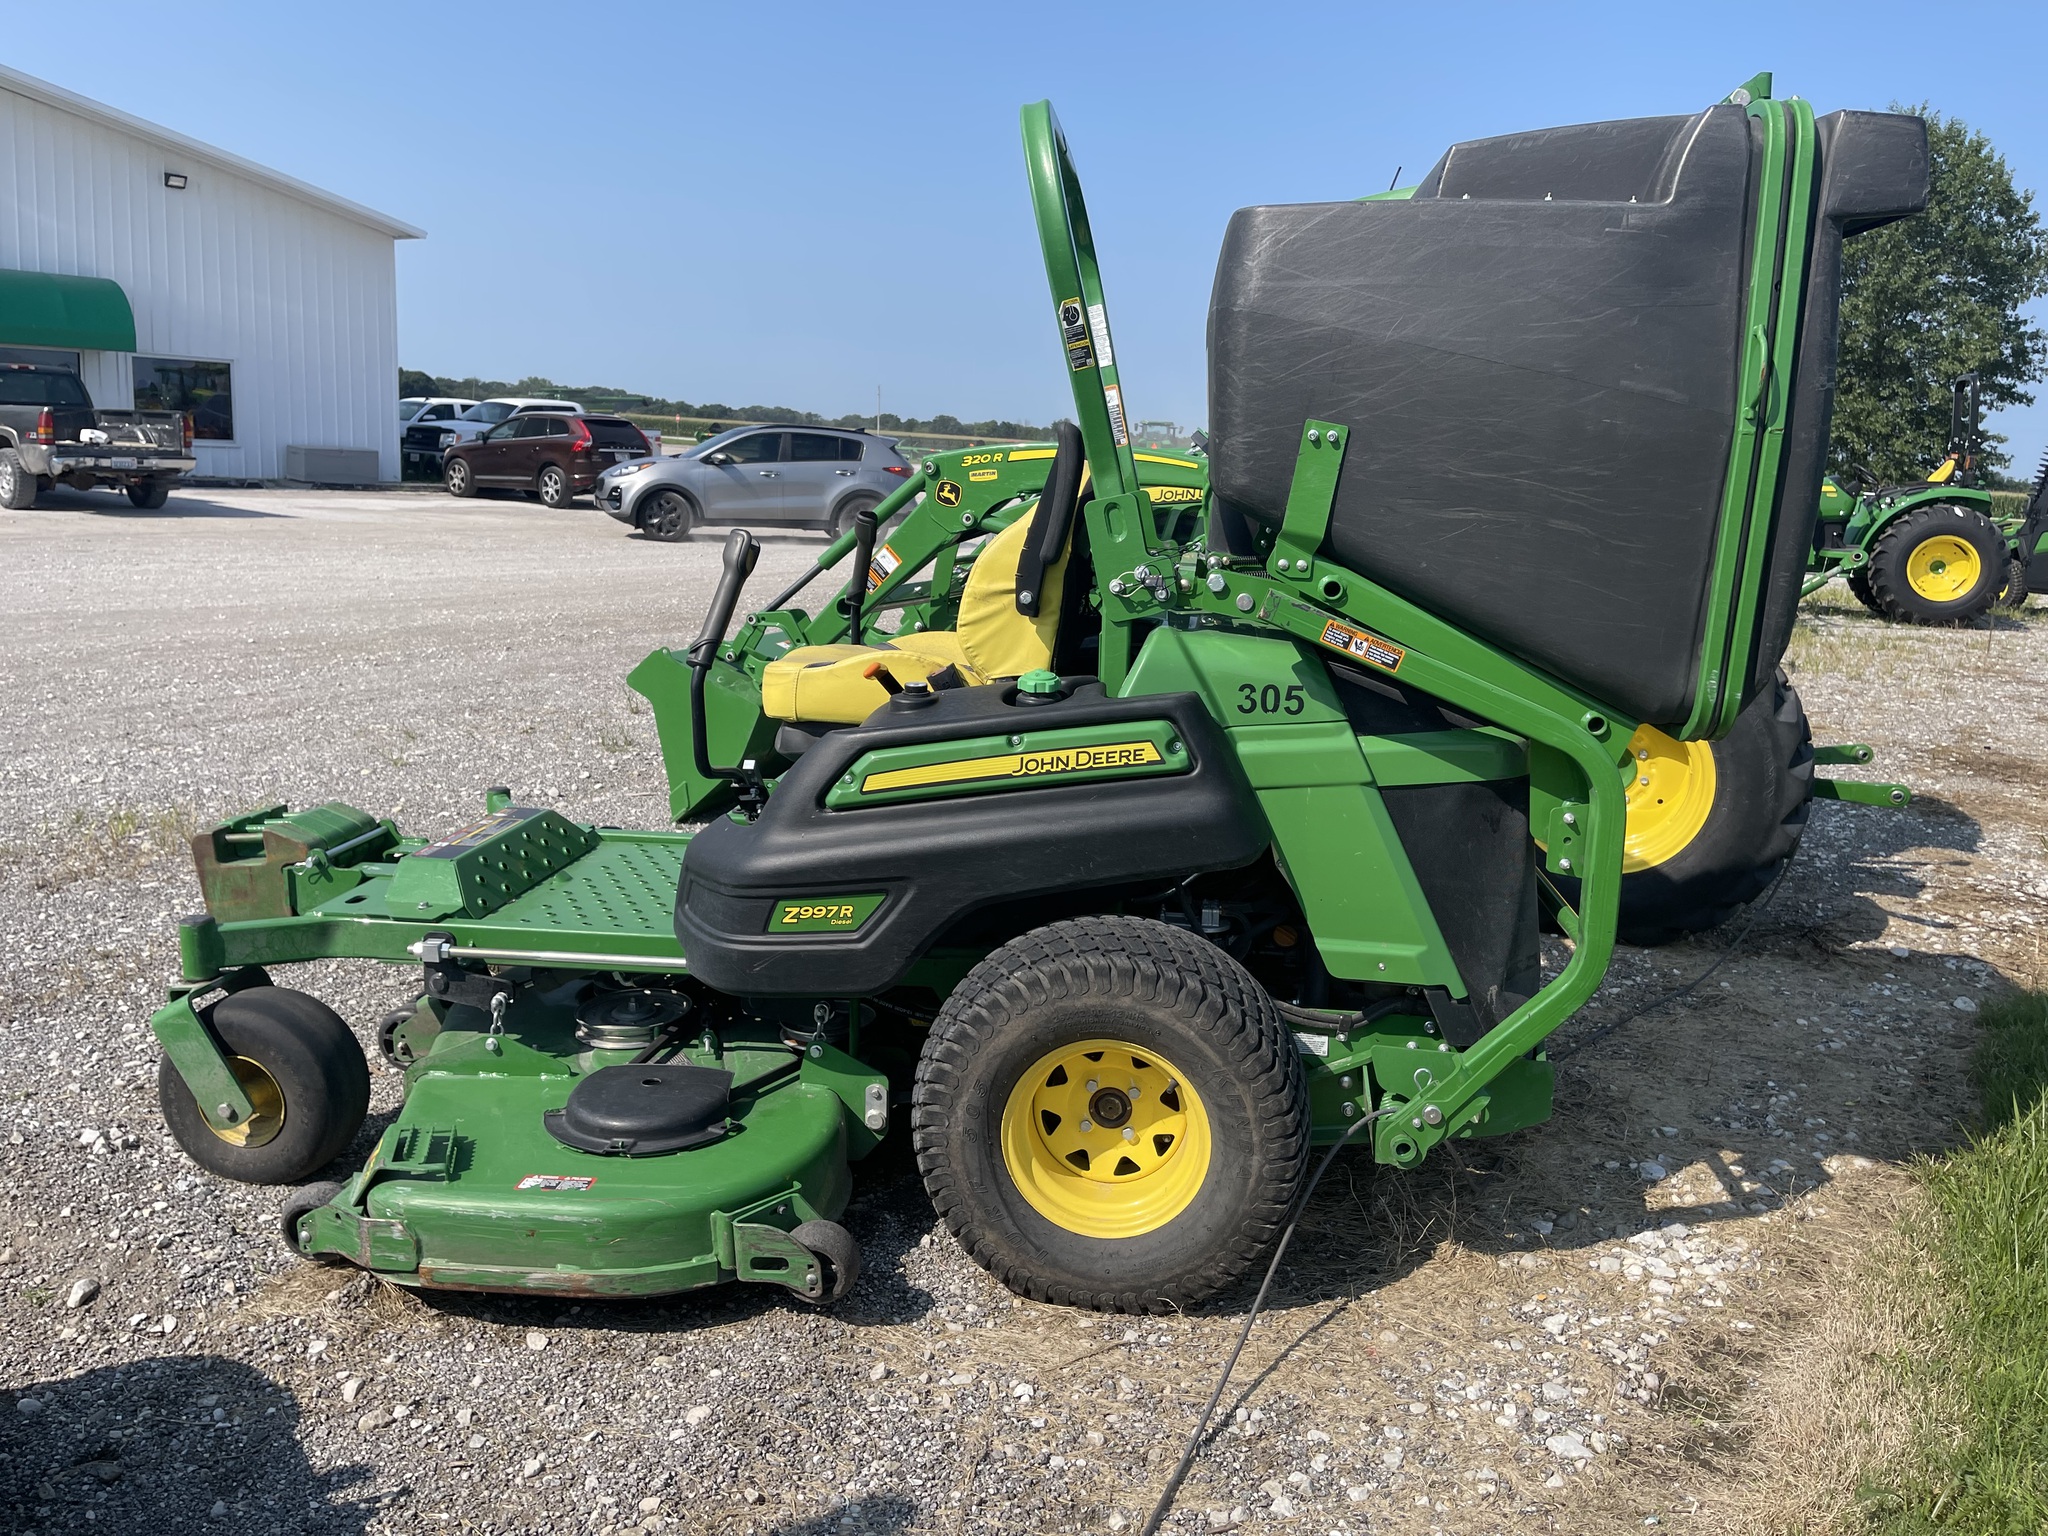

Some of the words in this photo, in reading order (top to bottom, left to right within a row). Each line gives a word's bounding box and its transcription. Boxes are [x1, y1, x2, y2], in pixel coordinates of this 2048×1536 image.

[961, 453, 991, 467] 320
[992, 452, 1003, 463] R
[971, 470, 996, 478] MARTIN
[1154, 488, 1196, 501] JOHN
[1335, 624, 1358, 637] WARNING
[1236, 683, 1305, 716] 305
[1012, 754, 1070, 774] JOHN
[1075, 748, 1145, 767] DEERE
